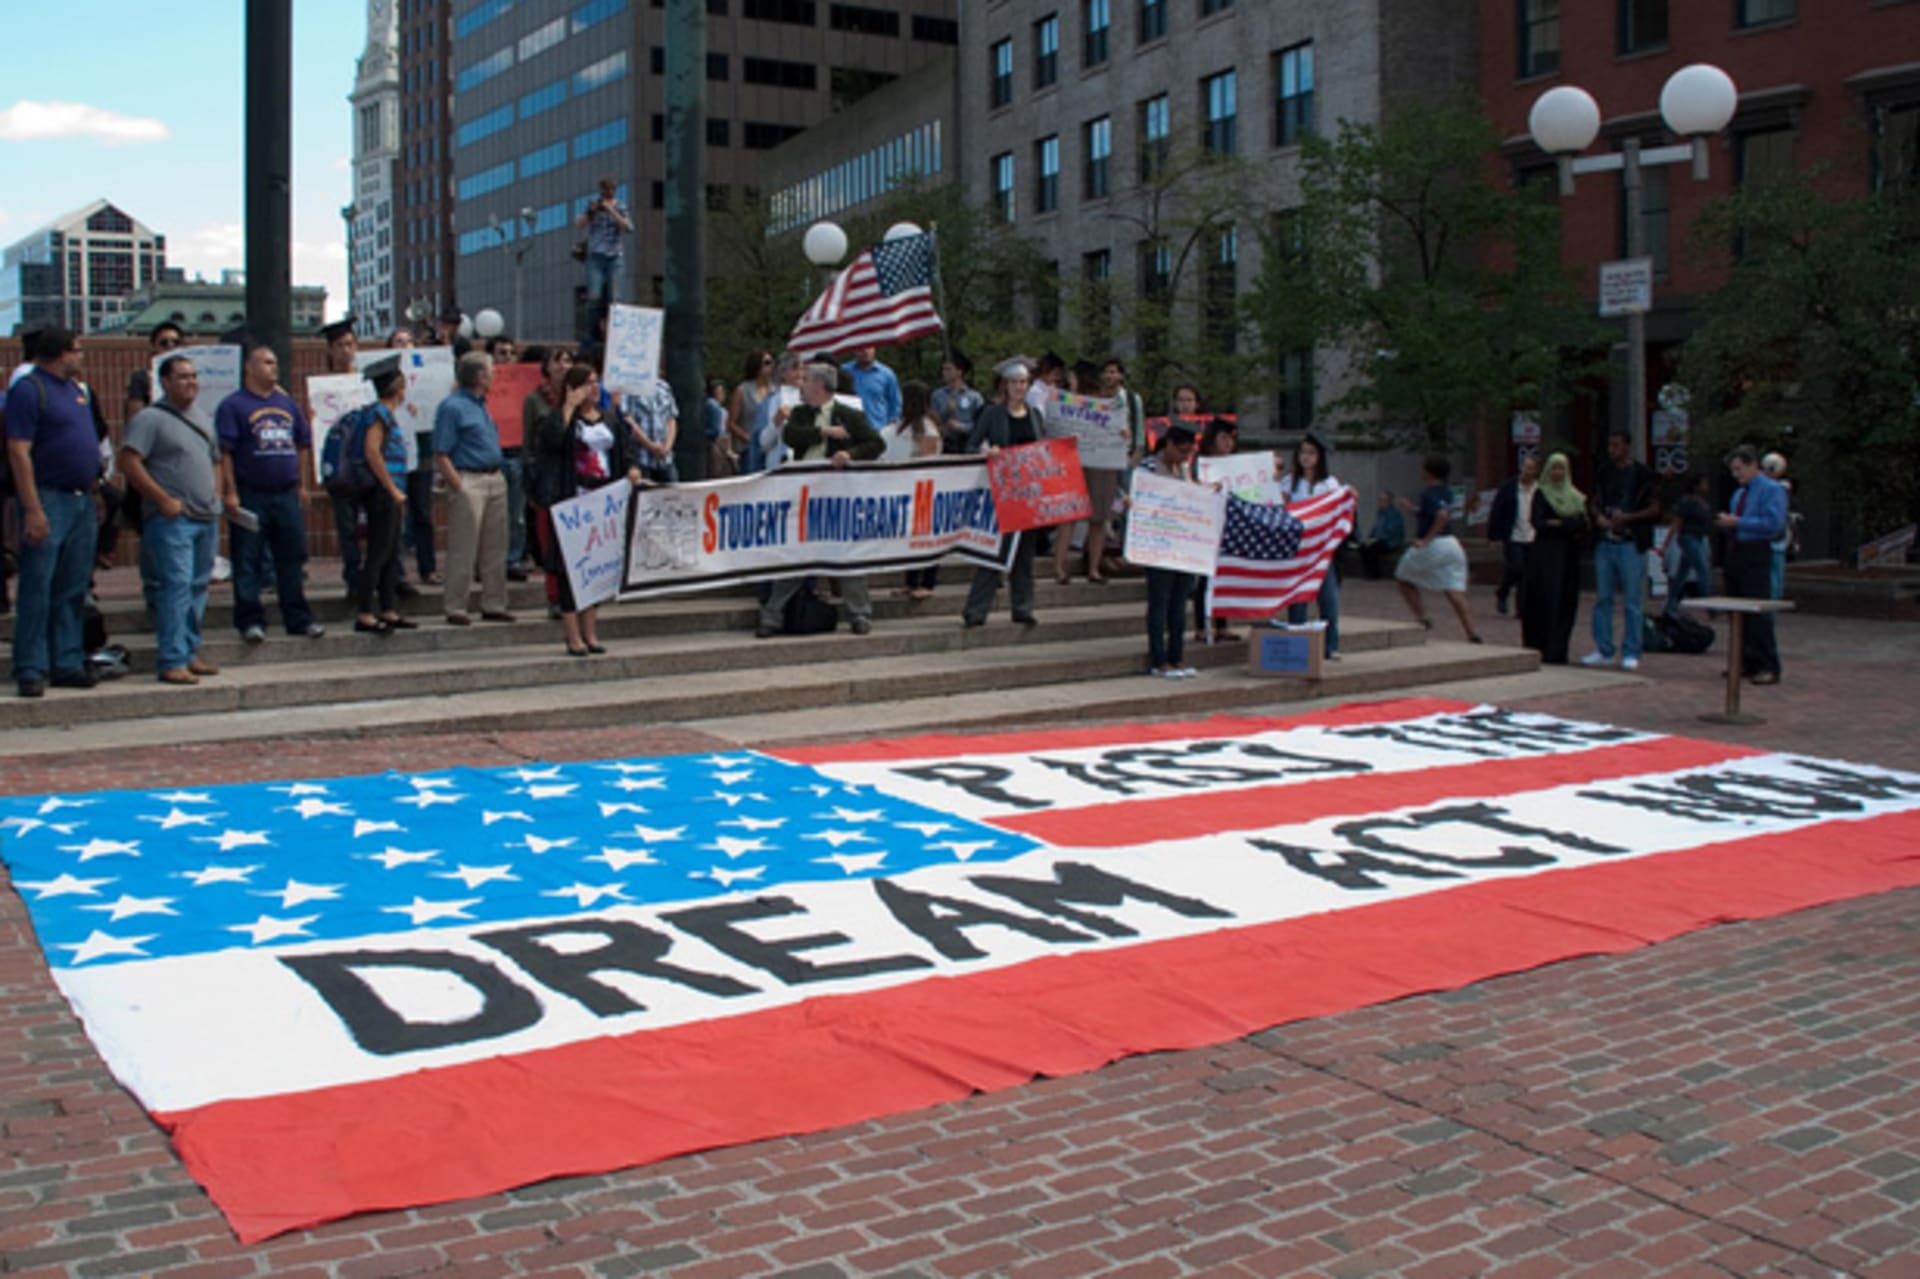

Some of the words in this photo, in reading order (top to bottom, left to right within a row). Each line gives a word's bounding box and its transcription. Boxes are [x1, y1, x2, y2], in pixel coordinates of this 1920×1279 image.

[557, 503, 595, 531] We
[603, 494, 625, 517] Ar
[584, 516, 617, 553] All
[798, 484, 911, 543] IMMIGRANT
[911, 479, 1000, 537] MOVEMEN
[275, 860, 1239, 1056] DREAM
[1246, 802, 1632, 889] ACT
